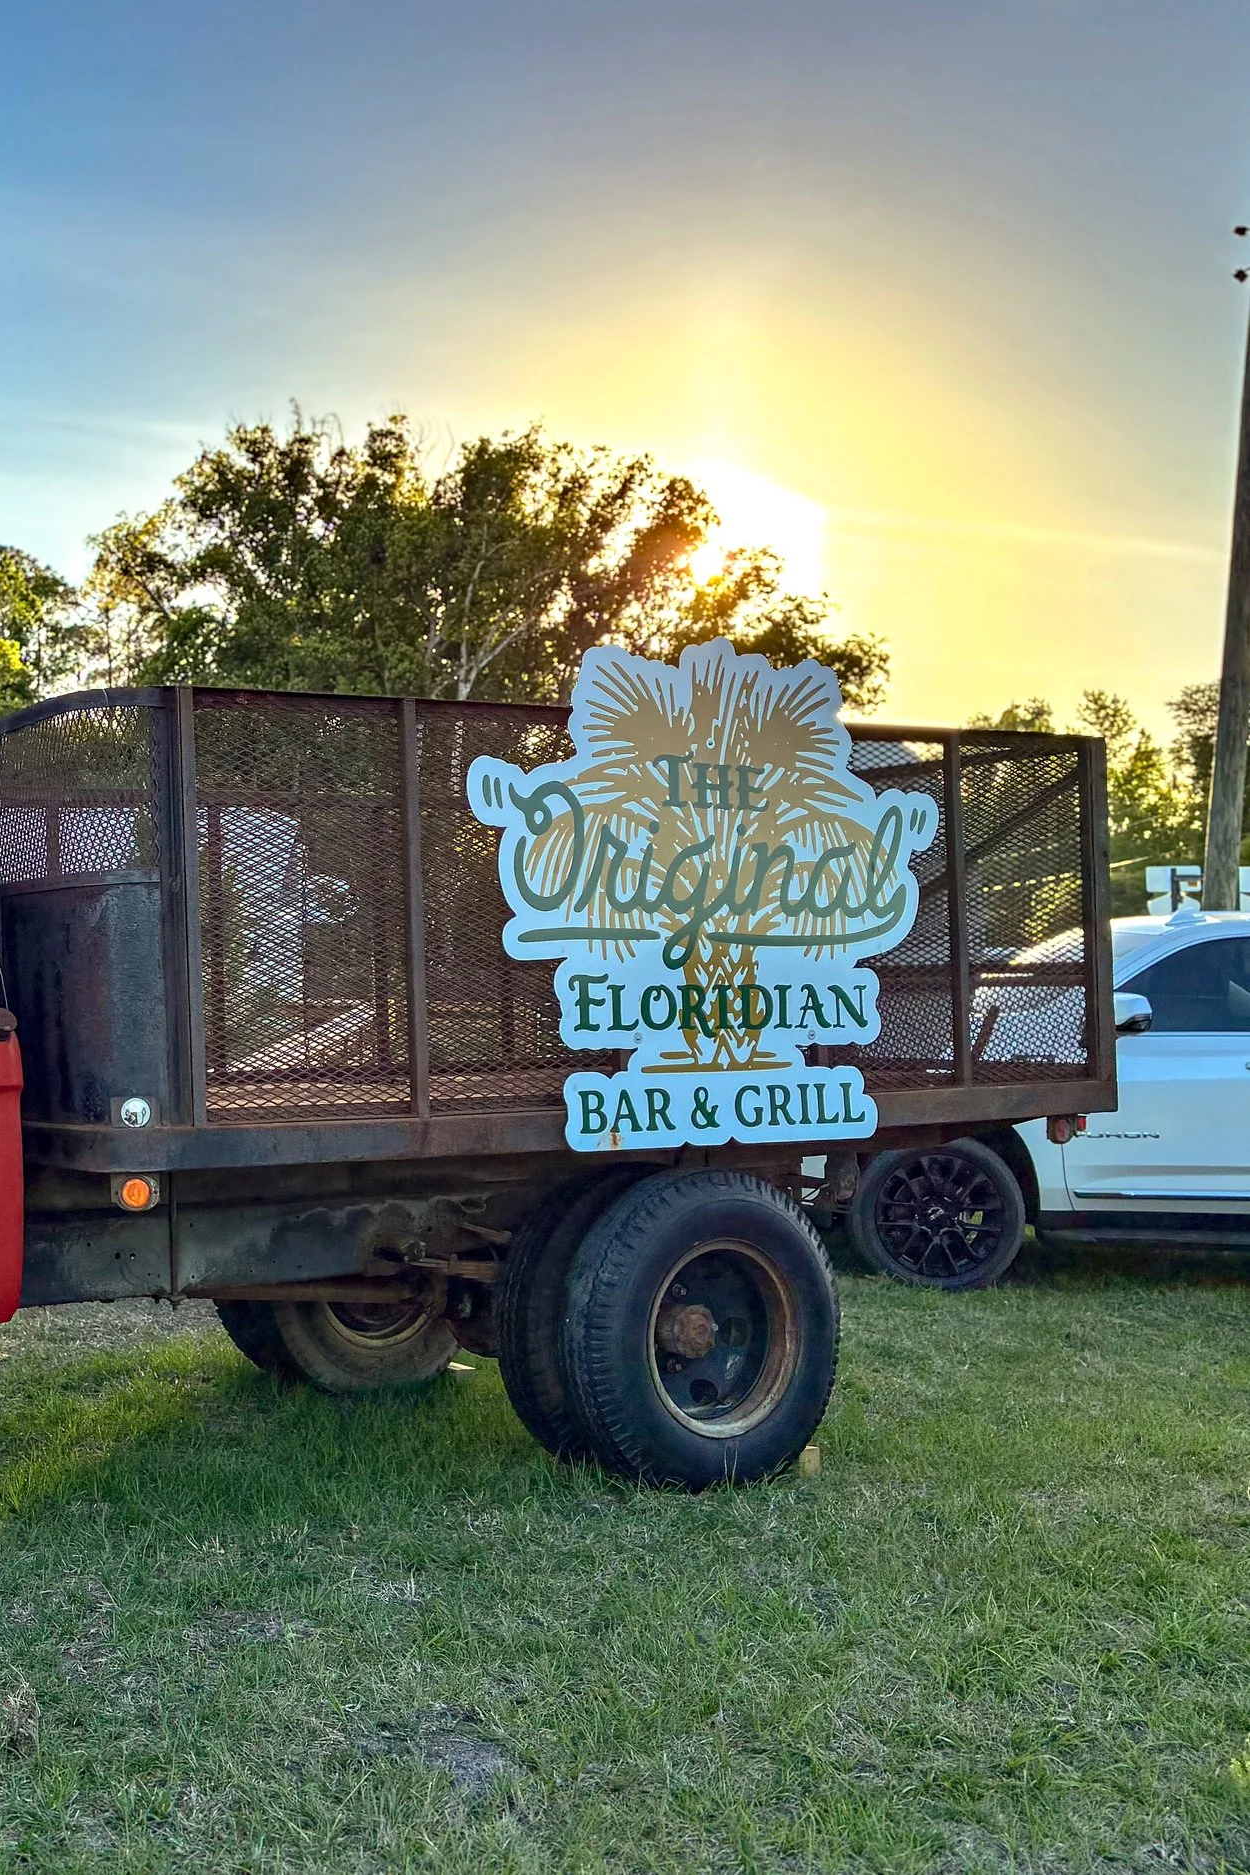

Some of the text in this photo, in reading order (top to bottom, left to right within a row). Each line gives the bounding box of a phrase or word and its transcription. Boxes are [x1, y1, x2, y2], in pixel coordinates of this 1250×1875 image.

[653, 754, 771, 812] THE
[568, 973, 869, 1038] FLORIDIAN
[578, 1082, 866, 1134] BAR & GRILL
